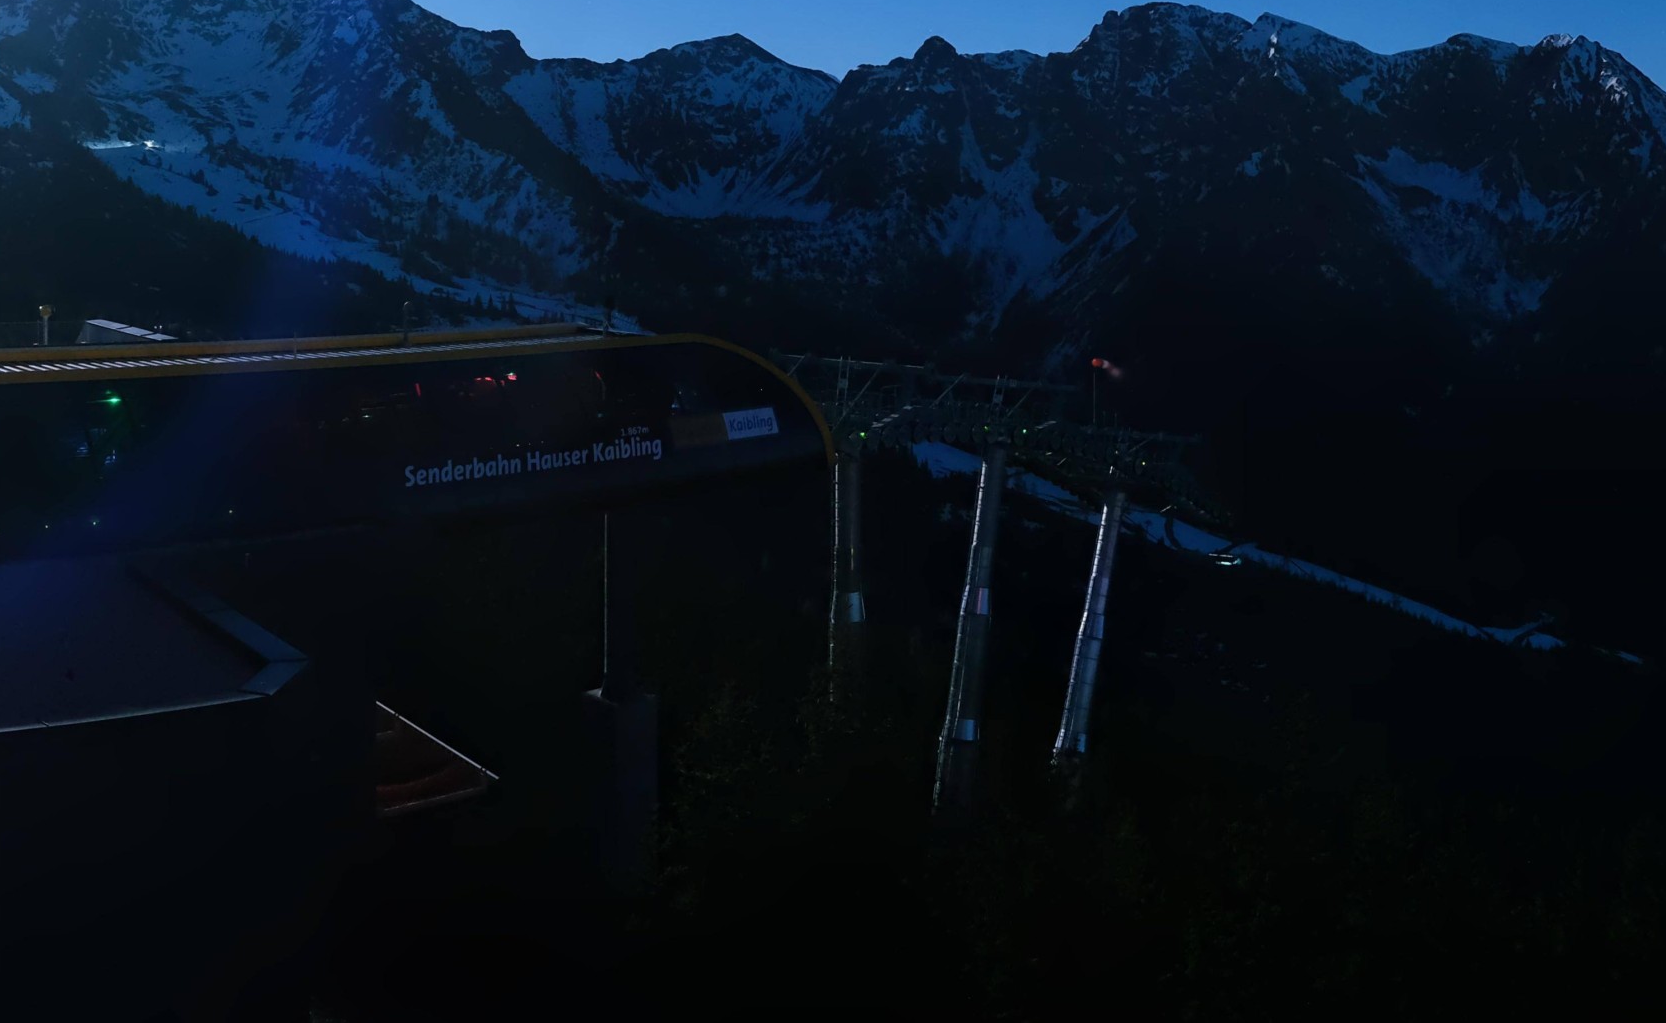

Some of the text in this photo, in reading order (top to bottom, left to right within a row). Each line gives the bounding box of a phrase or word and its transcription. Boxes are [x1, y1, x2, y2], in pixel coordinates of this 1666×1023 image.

[620, 425, 650, 436] 1.867m
[728, 415, 774, 434] Kaibling
[404, 436, 663, 488] Senderbahn Hauser Kaibling
